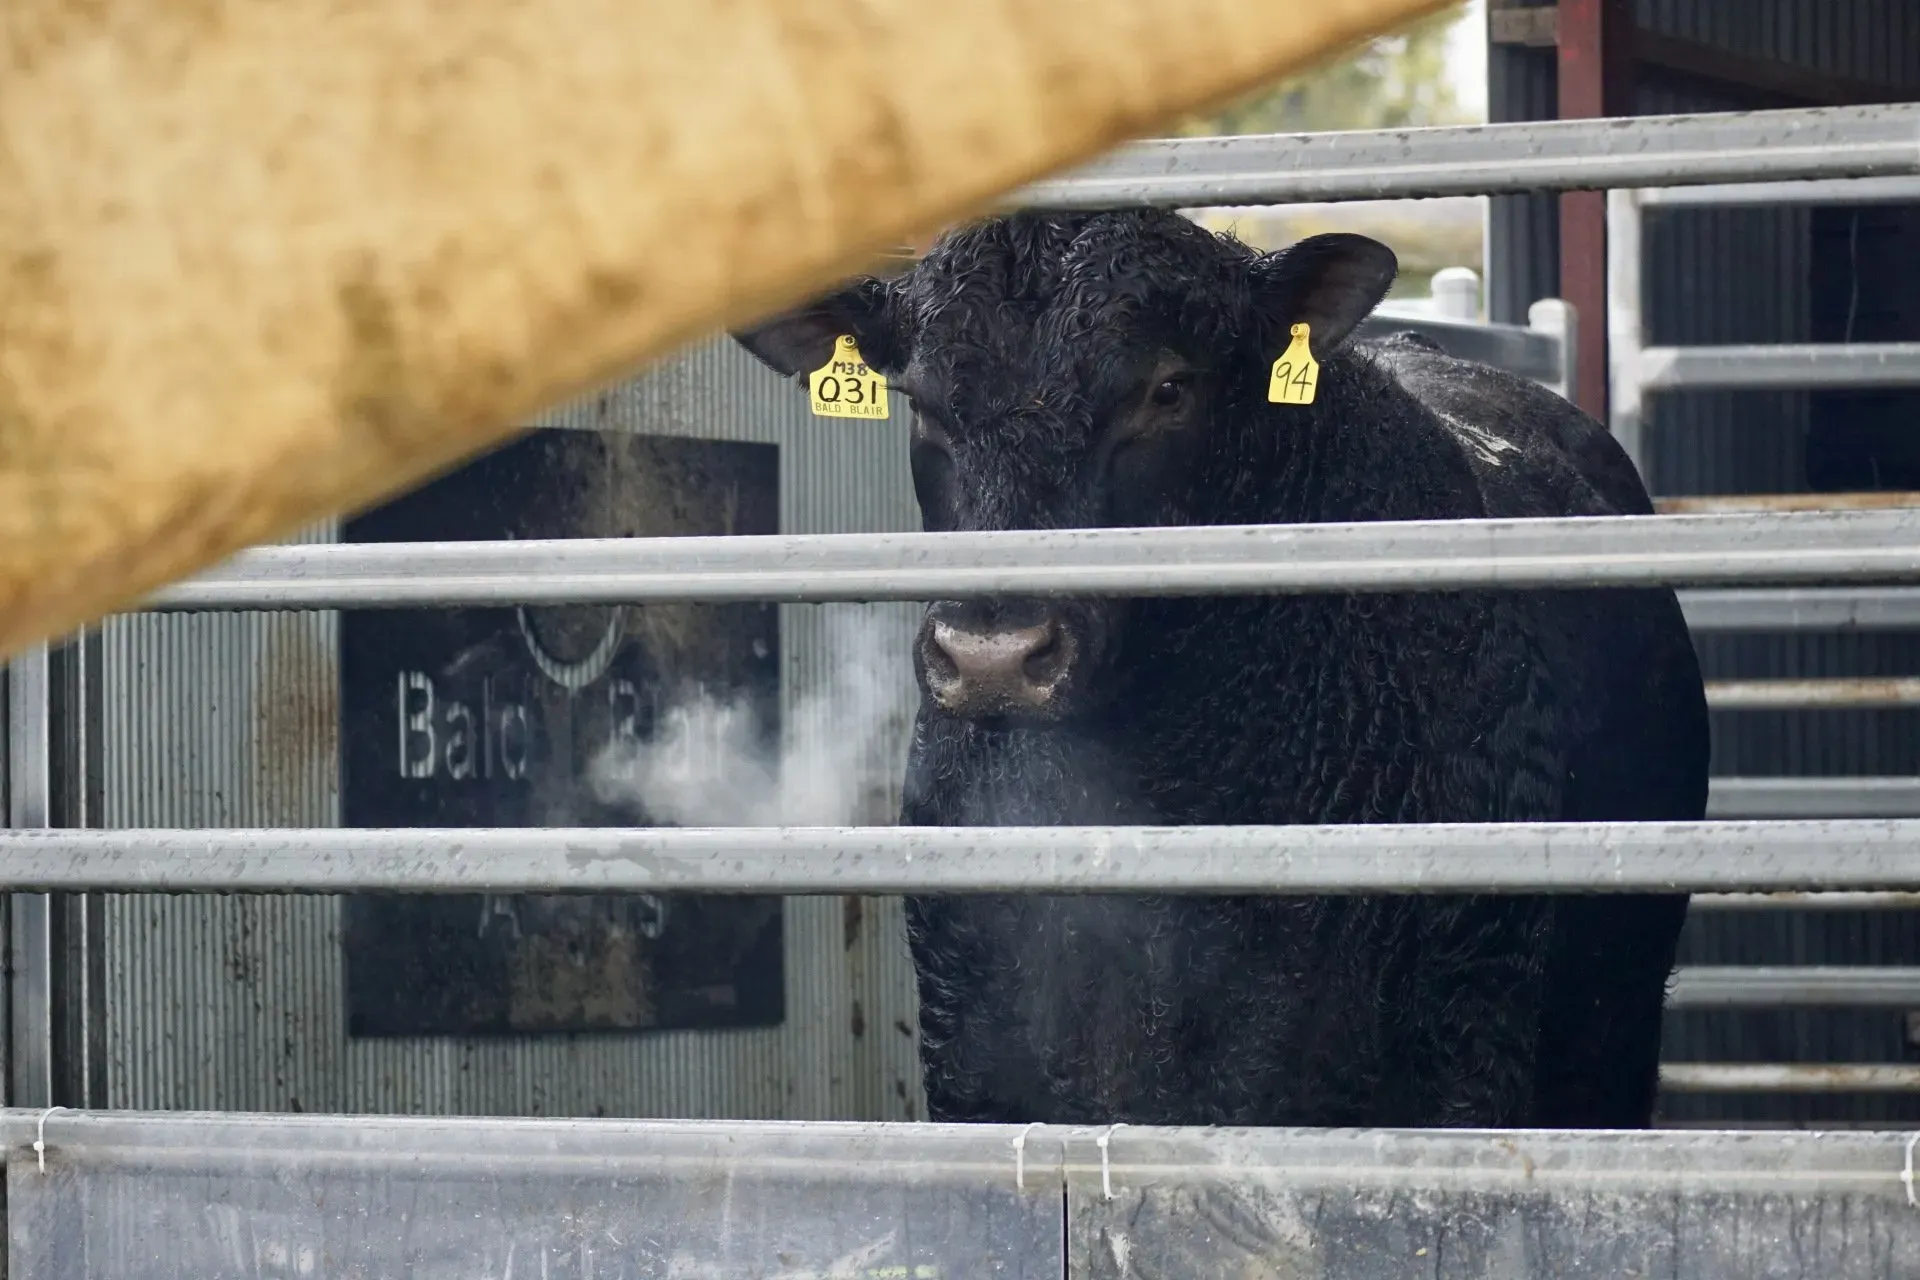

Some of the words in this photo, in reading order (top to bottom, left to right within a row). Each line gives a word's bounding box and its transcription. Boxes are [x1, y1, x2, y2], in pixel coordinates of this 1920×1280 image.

[832, 361, 868, 376] M38
[818, 376, 877, 405] Q31
[1276, 361, 1312, 401] 94
[815, 402, 842, 413] BALD
[850, 405, 883, 416] BLAIR
